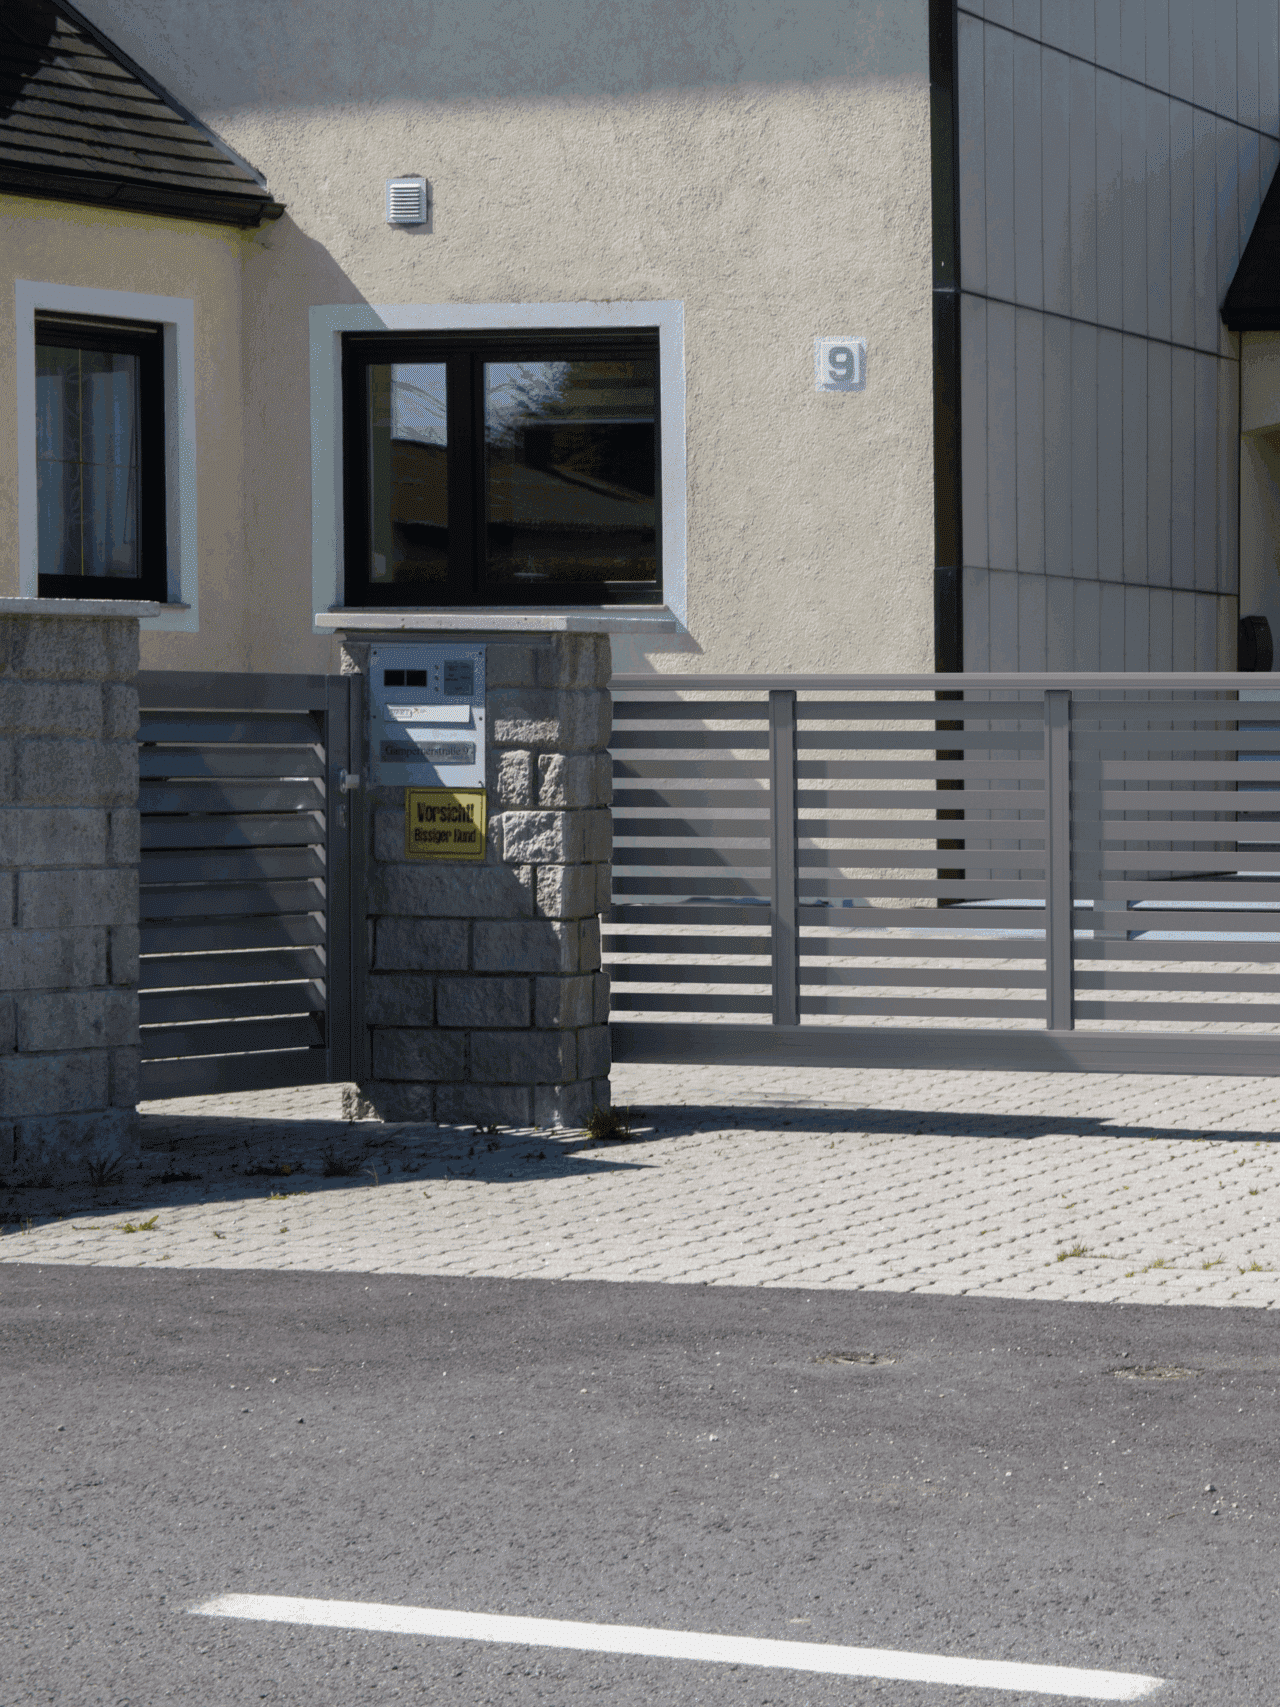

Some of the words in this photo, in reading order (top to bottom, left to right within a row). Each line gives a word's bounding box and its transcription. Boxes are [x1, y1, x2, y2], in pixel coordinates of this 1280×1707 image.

[828, 346, 855, 382] 9
[417, 802, 474, 823] Vorsicht!
[415, 827, 452, 844] Bissiger
[453, 828, 476, 843] Hund
